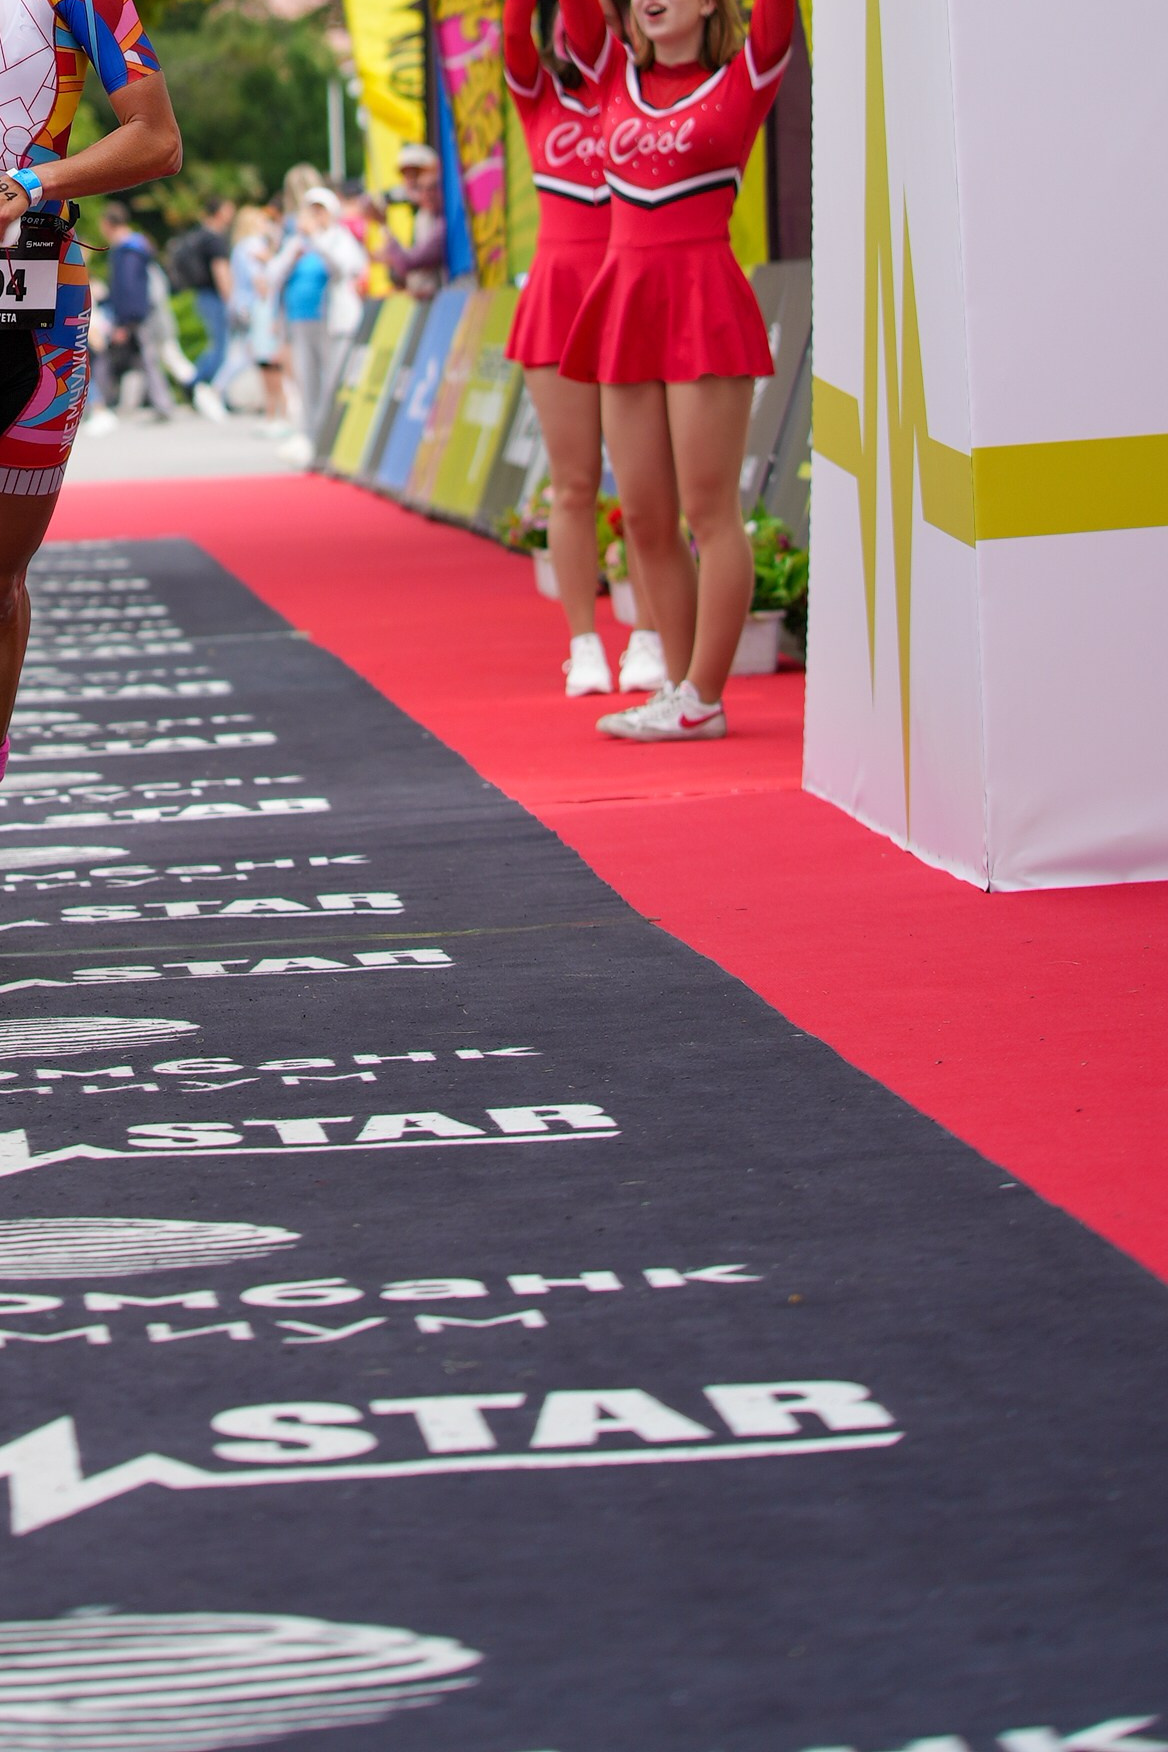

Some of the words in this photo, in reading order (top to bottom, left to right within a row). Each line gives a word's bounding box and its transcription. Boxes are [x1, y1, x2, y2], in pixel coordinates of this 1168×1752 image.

[609, 117, 696, 165] Cool
[60, 892, 406, 923] STAR
[72, 949, 454, 981] STAR
[126, 1103, 619, 1147] STAR
[209, 1379, 897, 1463] STAR
